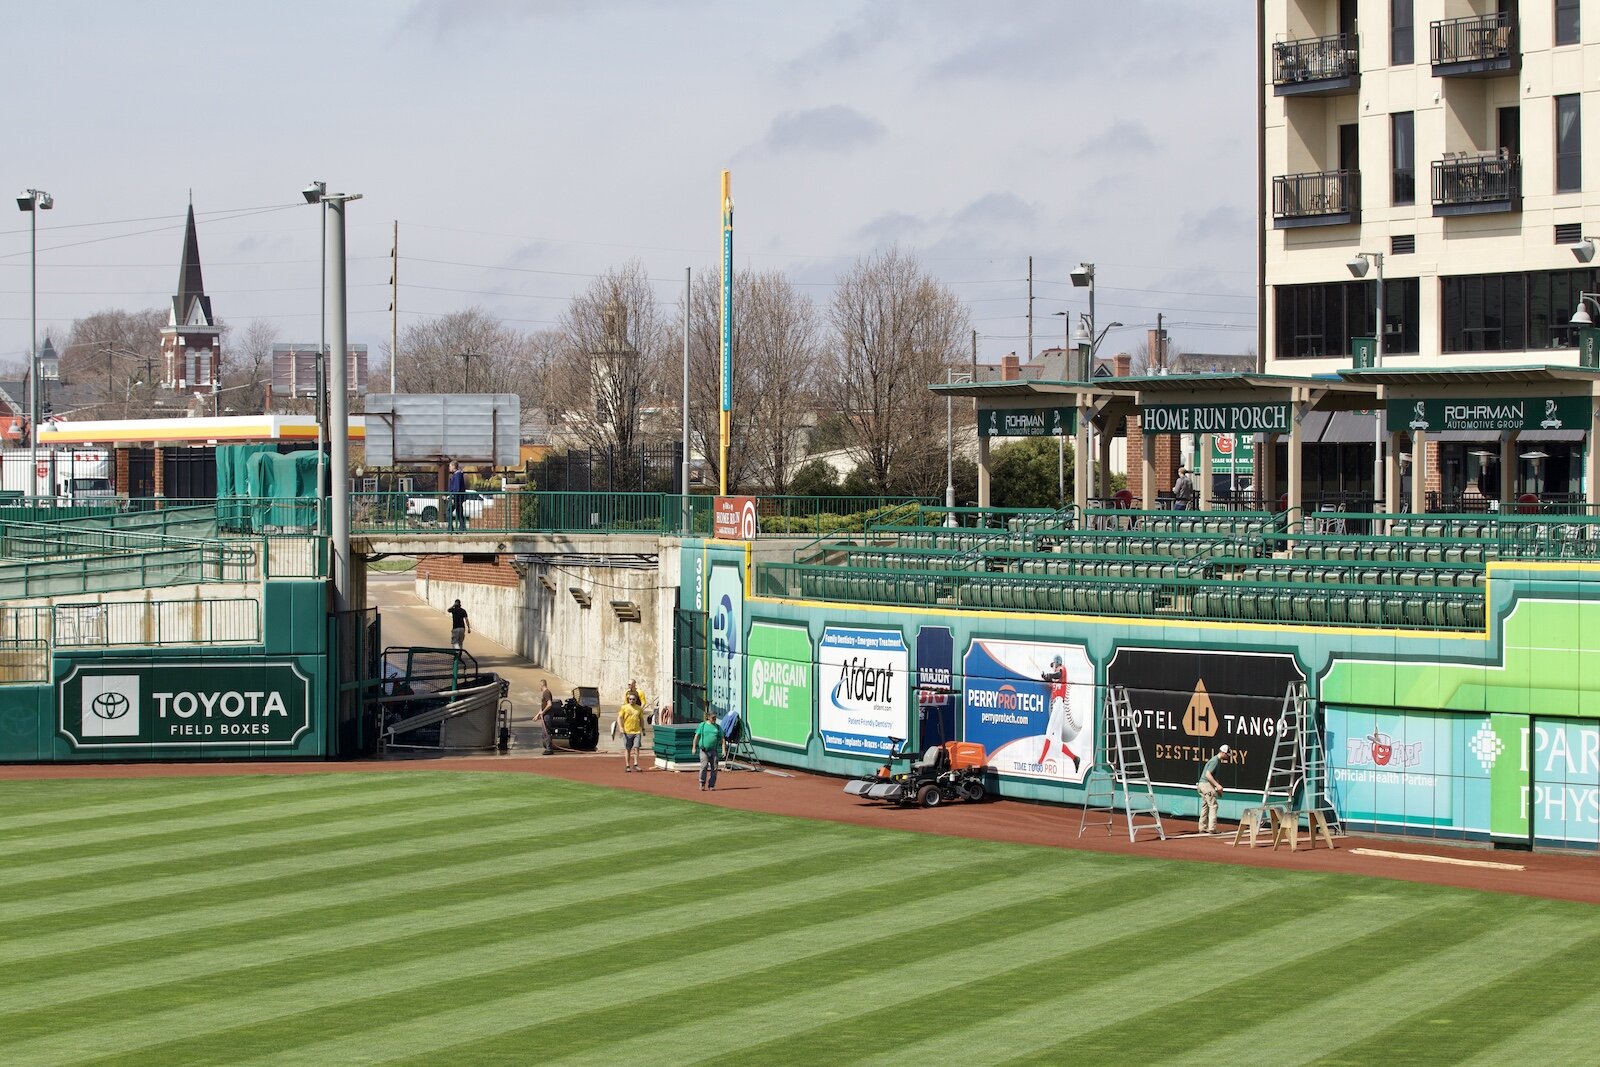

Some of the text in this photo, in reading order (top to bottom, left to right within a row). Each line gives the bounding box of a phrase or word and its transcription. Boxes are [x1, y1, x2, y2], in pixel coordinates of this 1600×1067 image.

[1005, 411, 1044, 430] ROHRMAN
[1144, 405, 1286, 430] HOME RUN PORCH
[1445, 401, 1523, 423] ROHRMAN
[1447, 420, 1524, 429] AUTOMOTIVE GROUP
[713, 664, 737, 681] BOWEN
[764, 661, 807, 688] BARGAIN
[836, 656, 894, 703] Afdent
[920, 667, 950, 684] MAJOR
[714, 685, 737, 701] HEALTH
[764, 684, 789, 708] LANE
[152, 691, 288, 718] TOYOTA
[981, 713, 1028, 724] perryprotech.com
[1121, 709, 1288, 737] HOTEL TANGO
[170, 723, 269, 735] FIELD BOXES
[880, 741, 900, 751] Cosmic
[1156, 744, 1248, 765] DISTILLRY
[1334, 769, 1437, 788] Official Health Partner
[1519, 785, 1600, 824] PHYS
